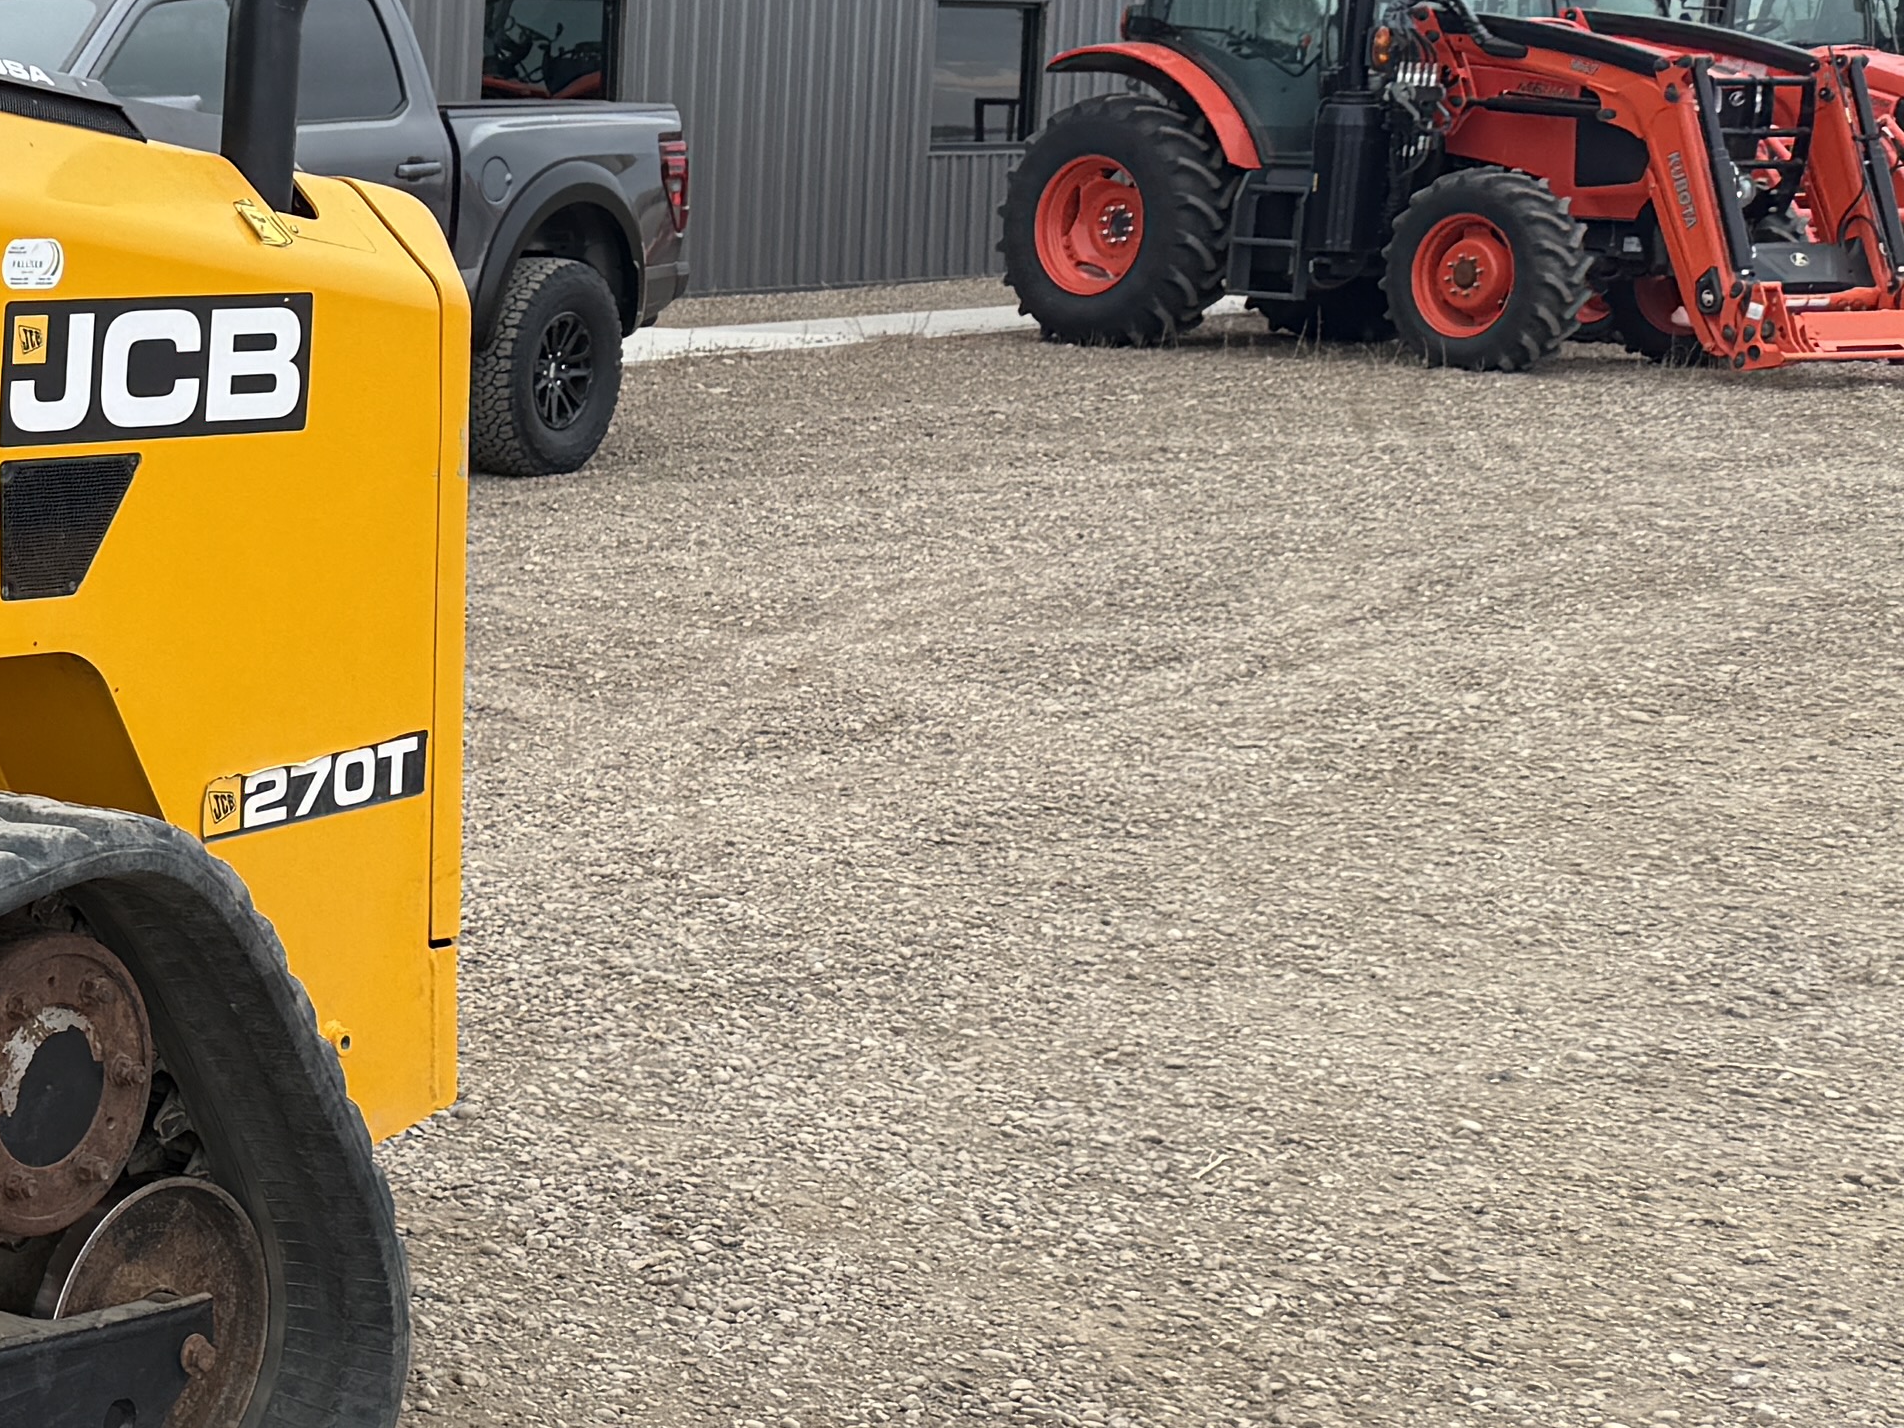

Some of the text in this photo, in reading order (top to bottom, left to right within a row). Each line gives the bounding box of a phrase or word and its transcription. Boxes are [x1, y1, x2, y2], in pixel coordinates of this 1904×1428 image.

[8, 305, 302, 433] JCB
[211, 790, 237, 822] JCB
[242, 736, 420, 829] 270T
